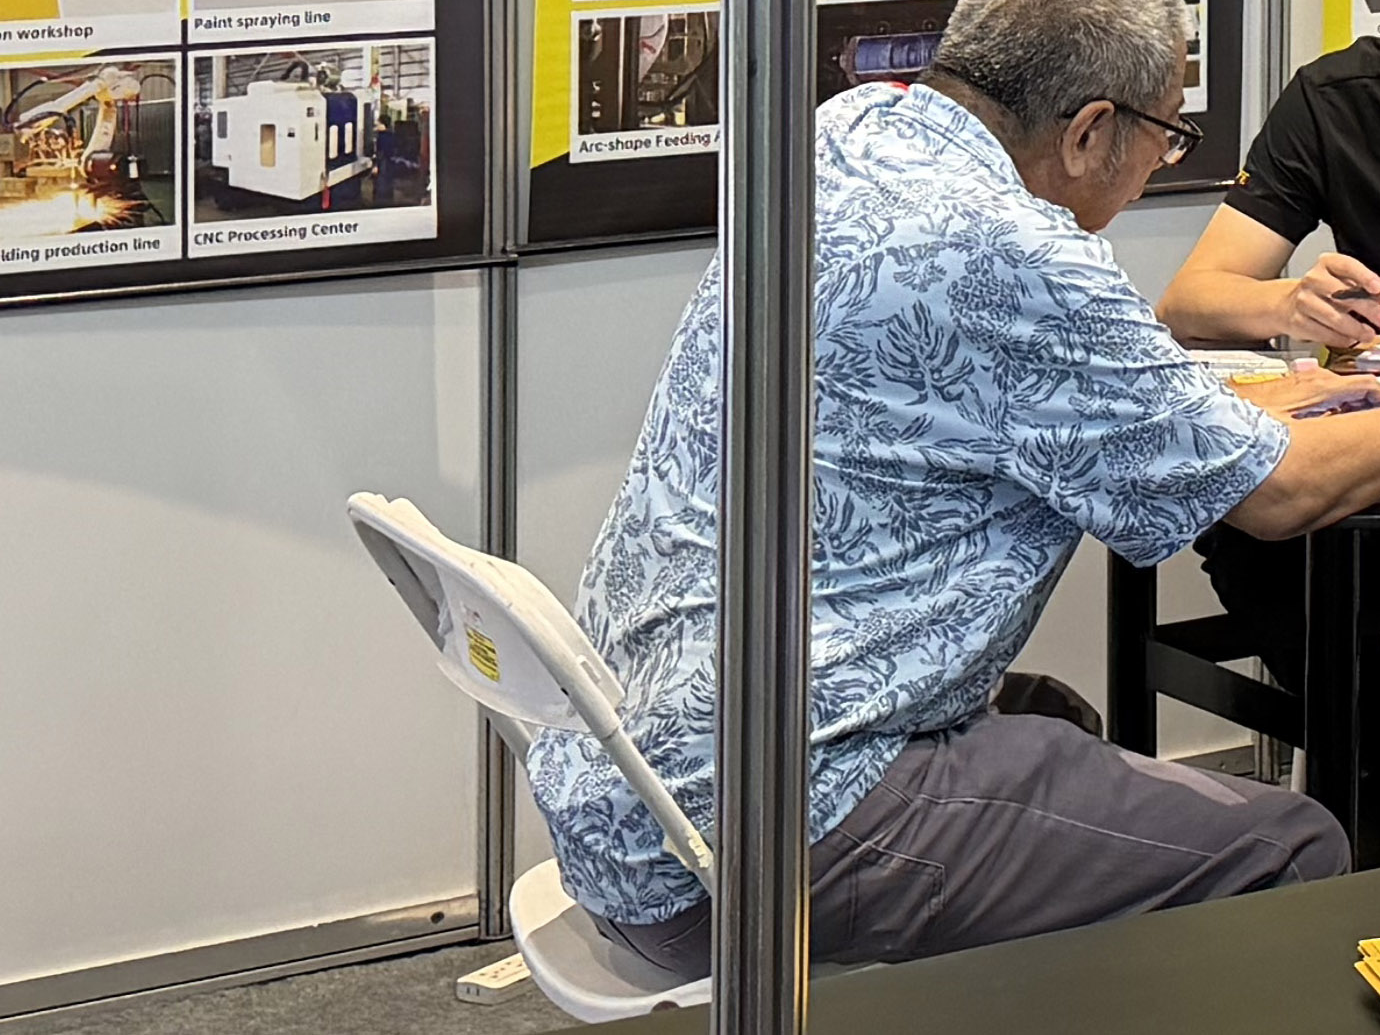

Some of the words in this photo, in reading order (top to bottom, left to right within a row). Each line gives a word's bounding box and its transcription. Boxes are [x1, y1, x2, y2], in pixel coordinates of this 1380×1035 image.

[195, 15, 232, 30] Paint
[237, 12, 300, 30] spraying
[305, 10, 331, 24] line
[17, 25, 93, 39] workshop
[580, 138, 651, 152] Arc-shape
[656, 132, 710, 146] Feeding
[195, 231, 223, 245] CNC
[229, 226, 307, 244] Processing
[311, 221, 358, 235] Center
[45, 241, 128, 260] production
[133, 238, 160, 250] line
